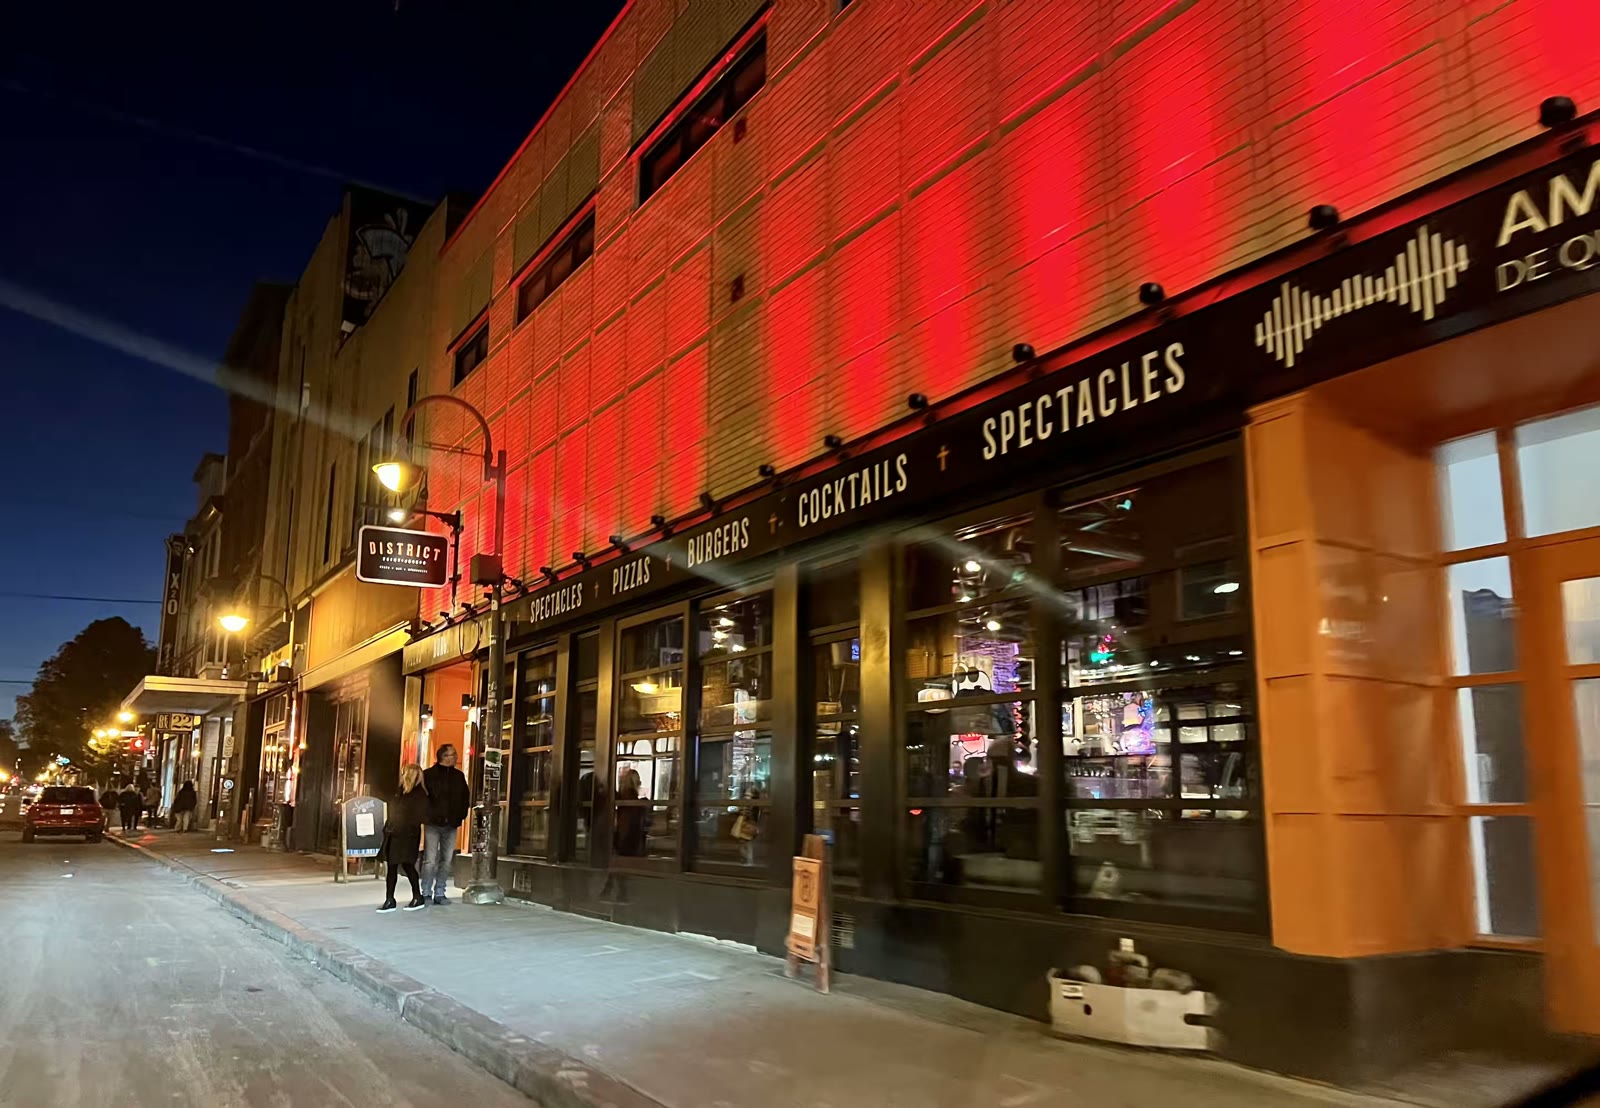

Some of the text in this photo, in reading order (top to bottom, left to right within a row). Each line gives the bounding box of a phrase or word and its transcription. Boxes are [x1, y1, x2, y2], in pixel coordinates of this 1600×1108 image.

[1497, 248, 1552, 293] DE
[530, 341, 1185, 624] SPECTACLES PIZZAS BURGERS COCKTAILS SPECTACLES
[368, 542, 441, 562] DISTRICT
[173, 715, 191, 729] 22
